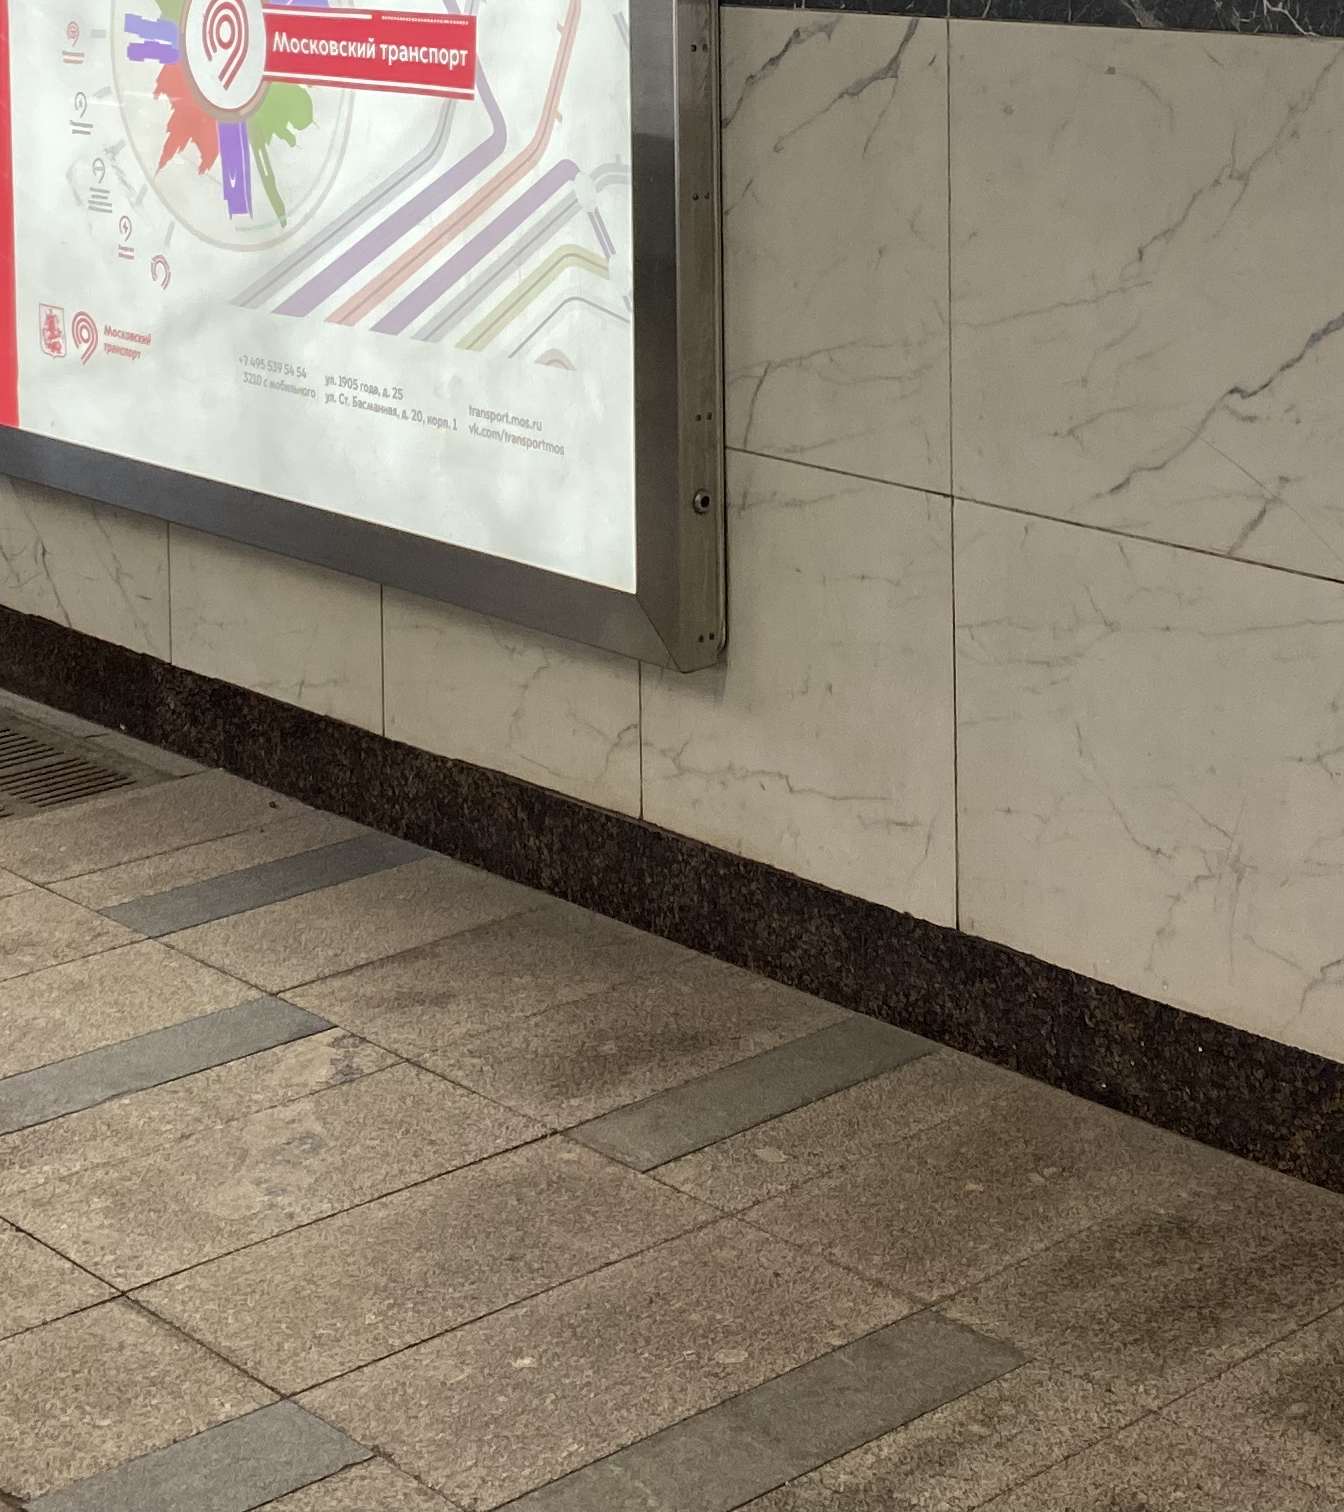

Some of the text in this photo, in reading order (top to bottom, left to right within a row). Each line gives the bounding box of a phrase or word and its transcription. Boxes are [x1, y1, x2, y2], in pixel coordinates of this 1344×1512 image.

[272, 31, 468, 70] Московский транспорт
[243, 371, 262, 386] 3210
[250, 356, 266, 370] 495
[267, 360, 282, 374] 539
[284, 363, 294, 377] 54
[296, 366, 306, 379] 54
[338, 374, 358, 390] 1905
[392, 386, 404, 400] 25
[468, 404, 542, 431] transport.mos.ru
[468, 422, 564, 455] vk.com/transportmos
